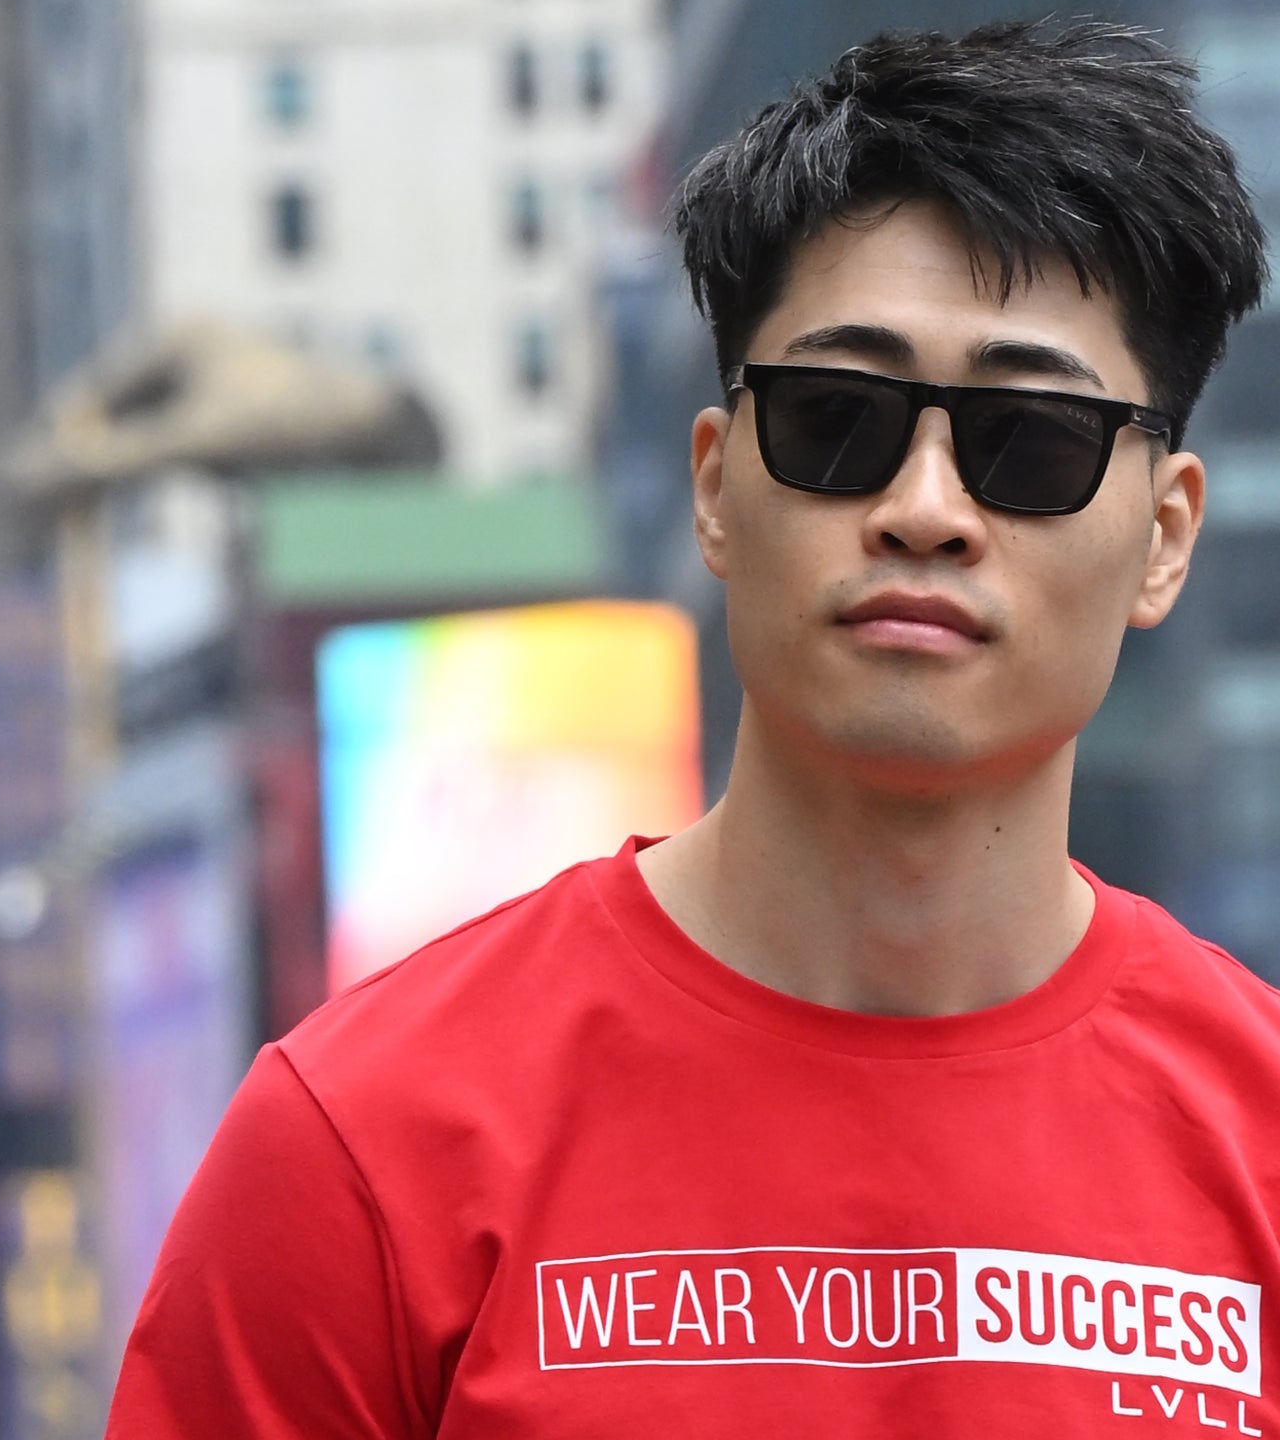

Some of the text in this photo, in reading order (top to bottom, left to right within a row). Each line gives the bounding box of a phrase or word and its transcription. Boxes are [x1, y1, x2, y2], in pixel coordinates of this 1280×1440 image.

[555, 1267, 1248, 1373] WEAR YOUR SUCCESS
[1111, 1382, 1262, 1437] LVLL
